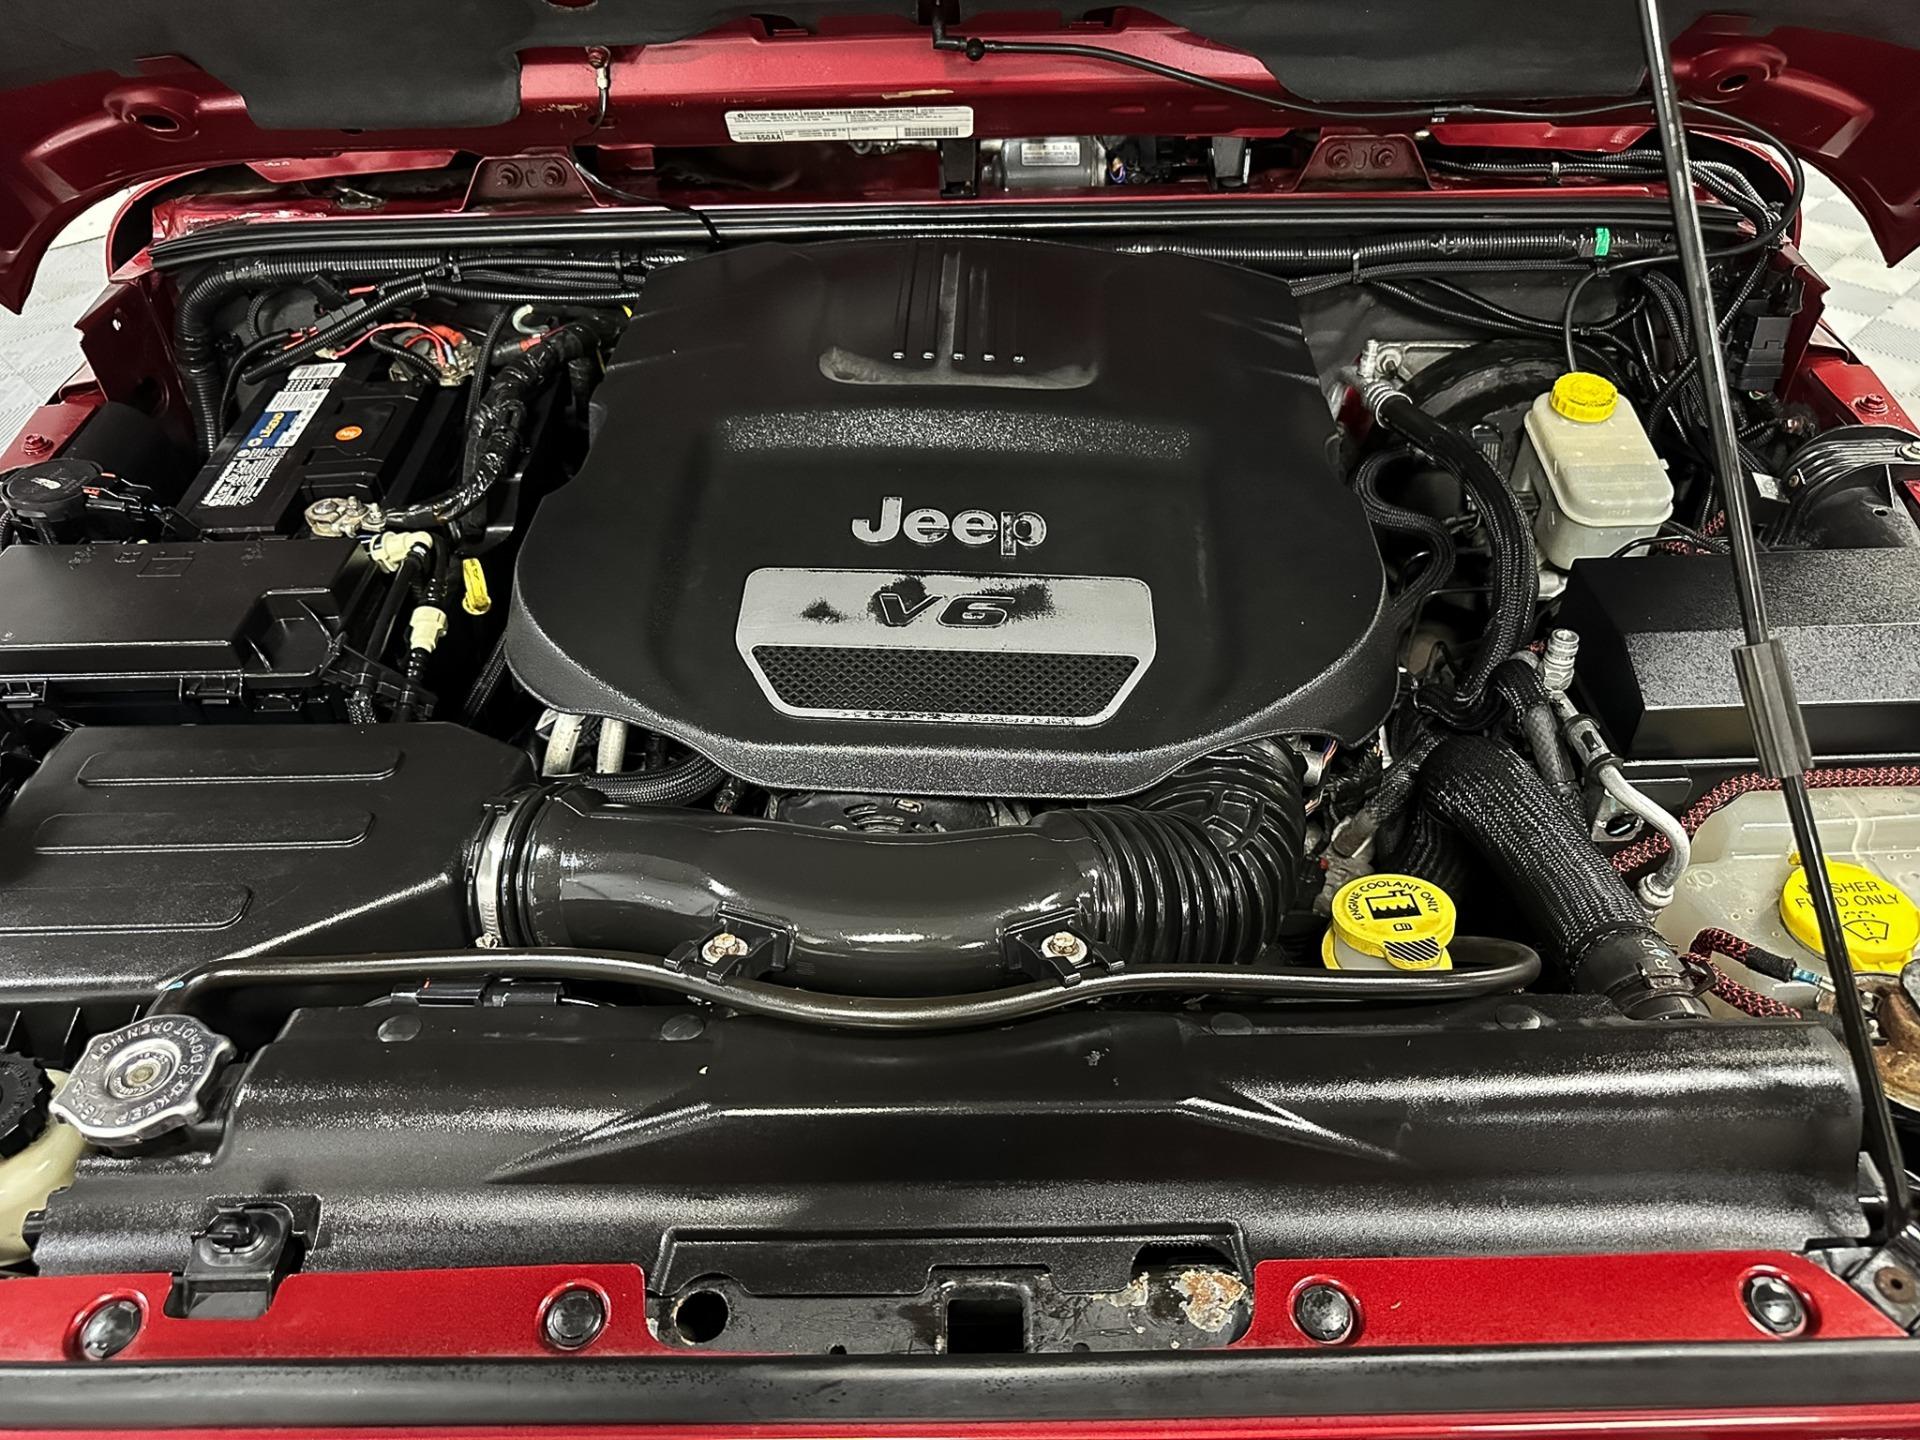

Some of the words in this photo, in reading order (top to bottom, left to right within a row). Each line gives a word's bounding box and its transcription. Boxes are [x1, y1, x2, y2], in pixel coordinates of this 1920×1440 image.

[851, 496, 1047, 557] Jeep
[879, 592, 1015, 629] V6
[1347, 891, 1365, 921] ENGINE
[1359, 880, 1422, 893] COOLANT
[1420, 891, 1440, 913] ONLY
[1799, 881, 1881, 894] WSHER
[1795, 895, 1849, 909] FLD
[1854, 893, 1900, 907] ONLY
[1641, 938, 1673, 970] RAD
[127, 1020, 174, 1040] OPEN
[177, 1063, 203, 1076] TVS
